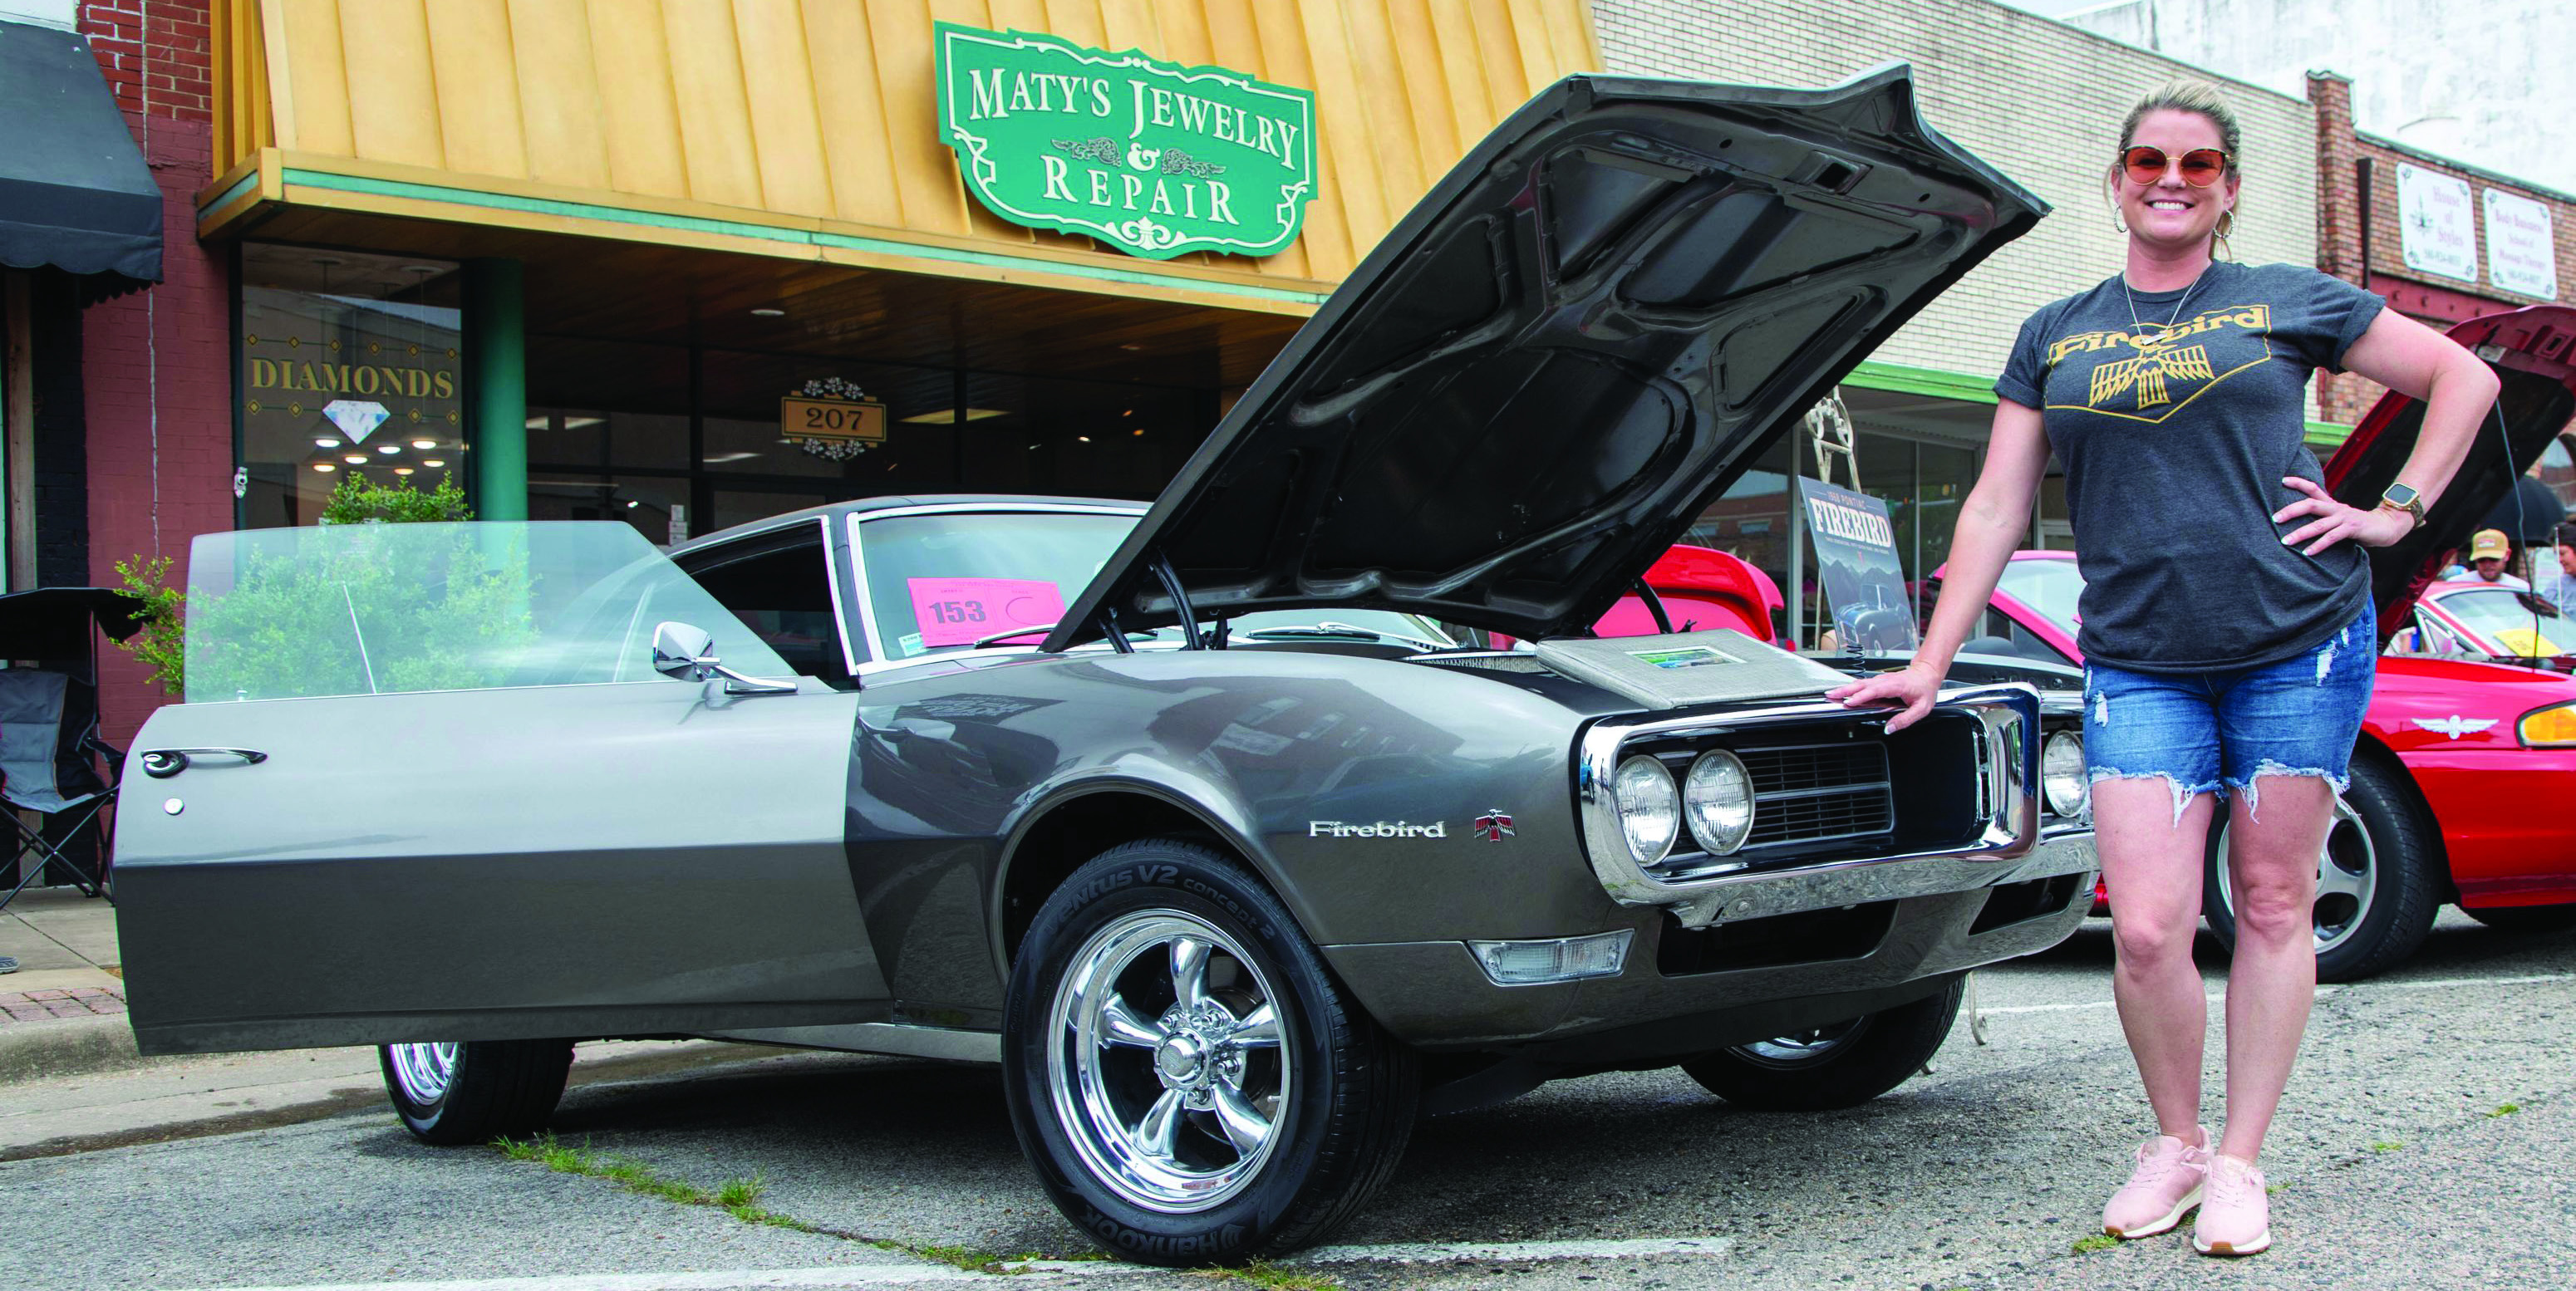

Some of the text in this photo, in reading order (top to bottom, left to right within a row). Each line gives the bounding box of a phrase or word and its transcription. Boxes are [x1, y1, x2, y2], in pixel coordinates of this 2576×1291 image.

[969, 67, 1300, 171] MATY'S JEWELRY
[1127, 142, 1162, 172] &
[1040, 154, 1240, 227] REPAIR
[251, 358, 455, 399] DIAMONDS
[806, 407, 863, 431] 207
[1841, 494, 1866, 509] PONTIAC
[1809, 498, 1891, 548] FIREBIRD
[929, 600, 986, 624] 153
[1309, 821, 1448, 838] Firebird
[1137, 865, 1178, 885] V2
[1183, 876, 1259, 928] concept
[1260, 925, 1276, 940] 2
